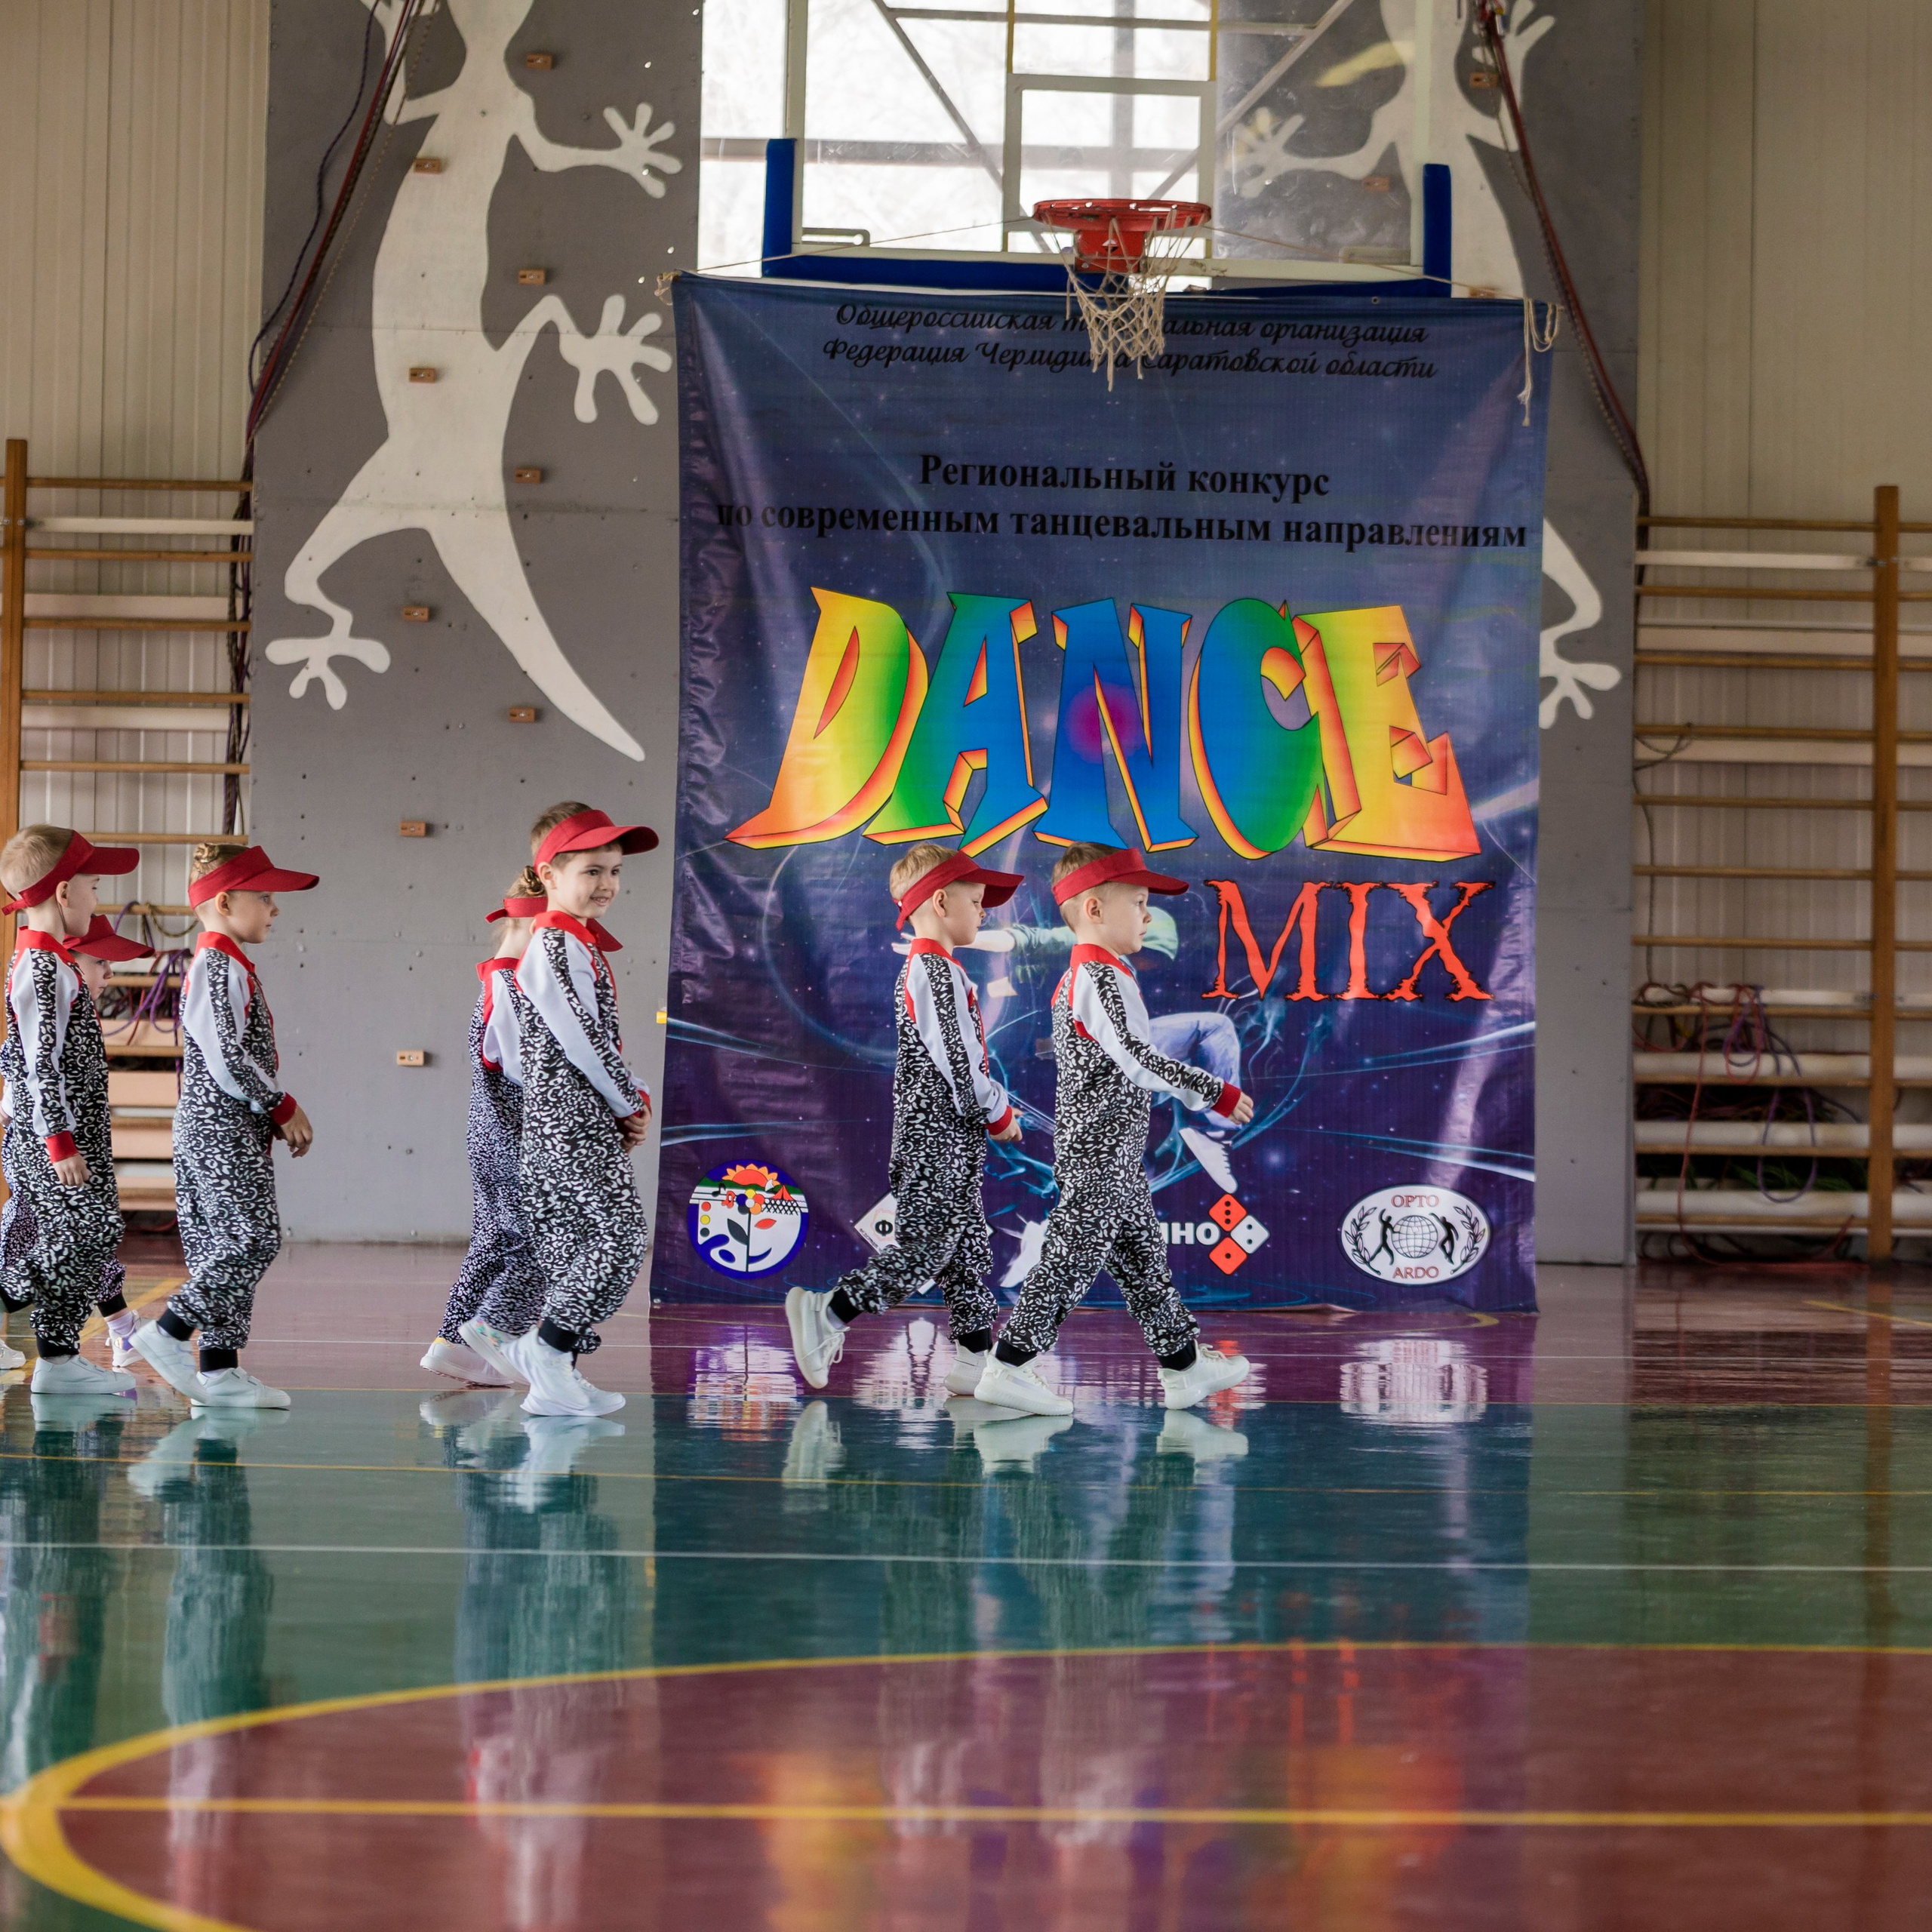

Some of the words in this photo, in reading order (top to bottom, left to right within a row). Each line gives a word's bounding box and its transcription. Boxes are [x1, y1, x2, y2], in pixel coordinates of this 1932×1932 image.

[1260, 319, 1429, 348] организация
[823, 338, 970, 368] Федерация
[1325, 351, 1439, 379] области
[918, 455, 1176, 492] Региональный
[1187, 468, 1331, 503] конкурс
[716, 503, 752, 528] по
[761, 505, 999, 538] современным
[1010, 512, 1270, 541] танцевальным
[1282, 520, 1527, 552] направлениям
[724, 586, 1481, 863] DANCE
[1201, 878, 1495, 1002] MIX
[1392, 1266, 1439, 1279] ARDO
